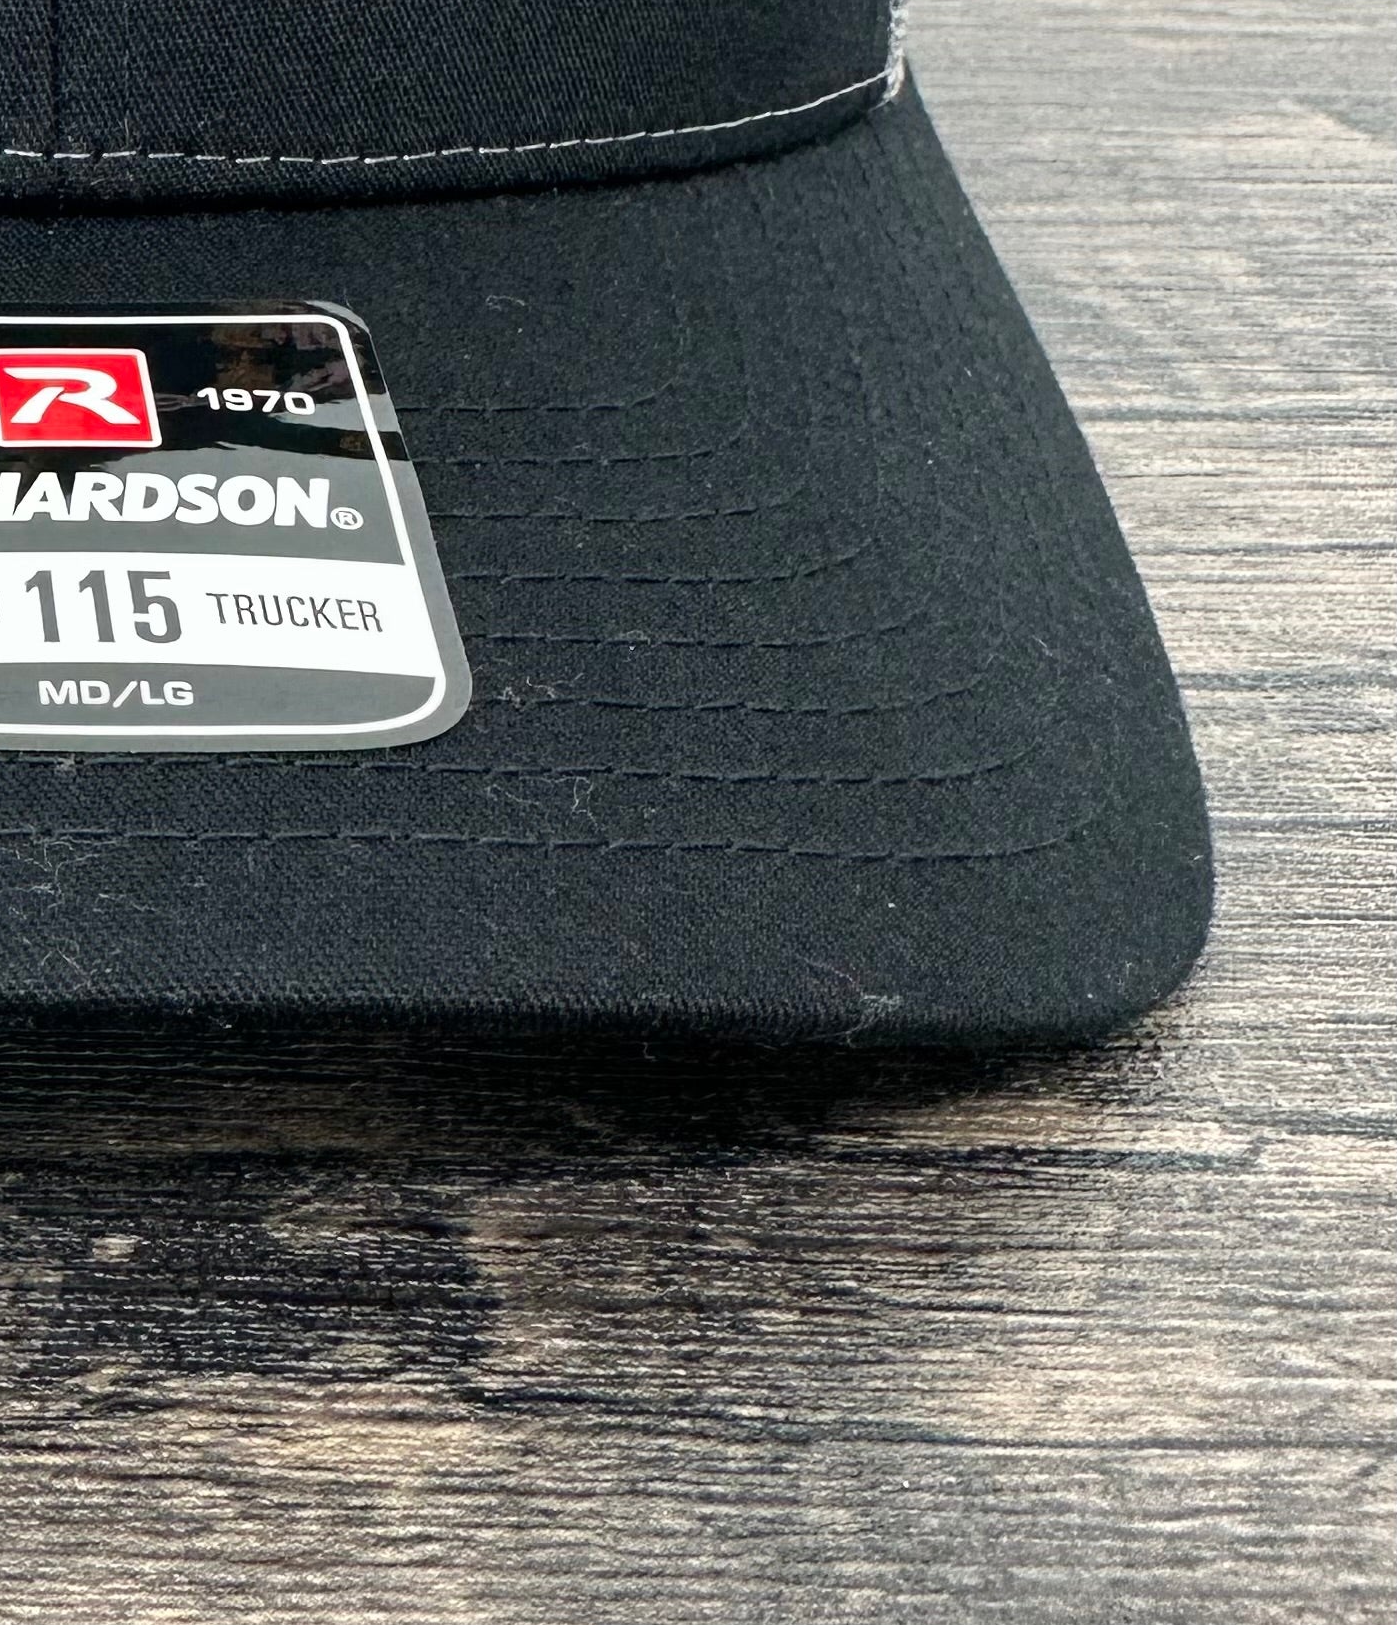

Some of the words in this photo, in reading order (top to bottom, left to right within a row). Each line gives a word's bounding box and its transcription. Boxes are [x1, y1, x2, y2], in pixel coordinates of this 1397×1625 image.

[197, 387, 317, 416] 1970
[25, 570, 183, 644] 115
[206, 592, 384, 634] TRUCKER
[38, 680, 195, 709] MD/LG
